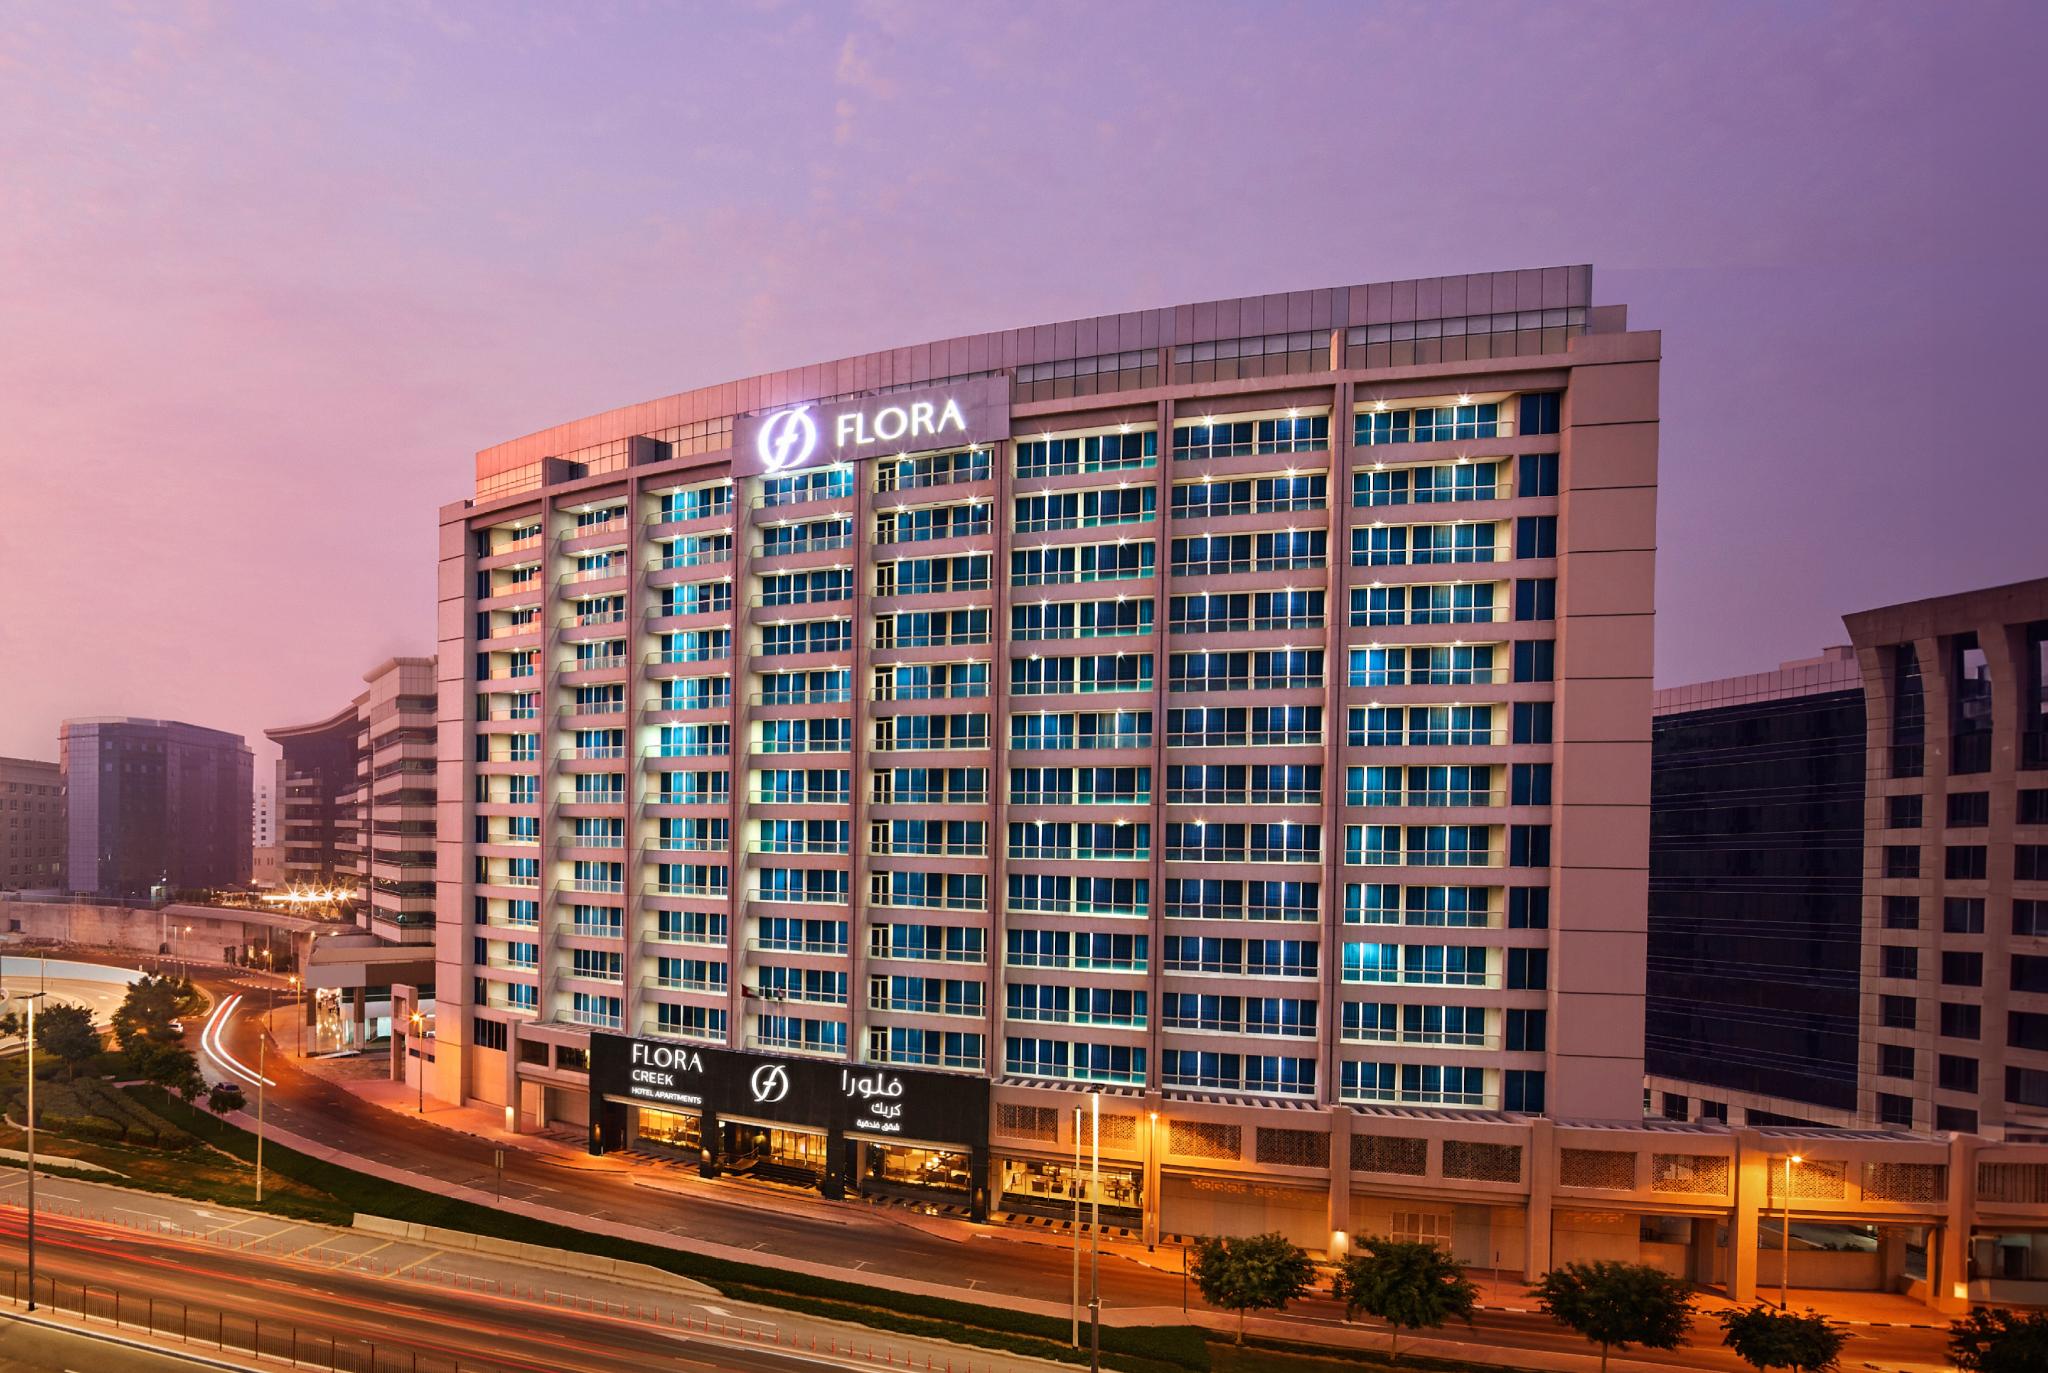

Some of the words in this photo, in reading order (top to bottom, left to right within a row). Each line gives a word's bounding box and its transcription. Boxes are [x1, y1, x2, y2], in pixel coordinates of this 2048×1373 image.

[836, 399, 966, 447] FLORA
[632, 1043, 703, 1073] FLORA
[632, 1069, 674, 1087] CREEK
[842, 1069, 903, 1099] فلورا
[631, 1086, 654, 1097] HOTEL
[654, 1090, 702, 1104] APARTMENTS
[870, 1101, 902, 1119] كريك
